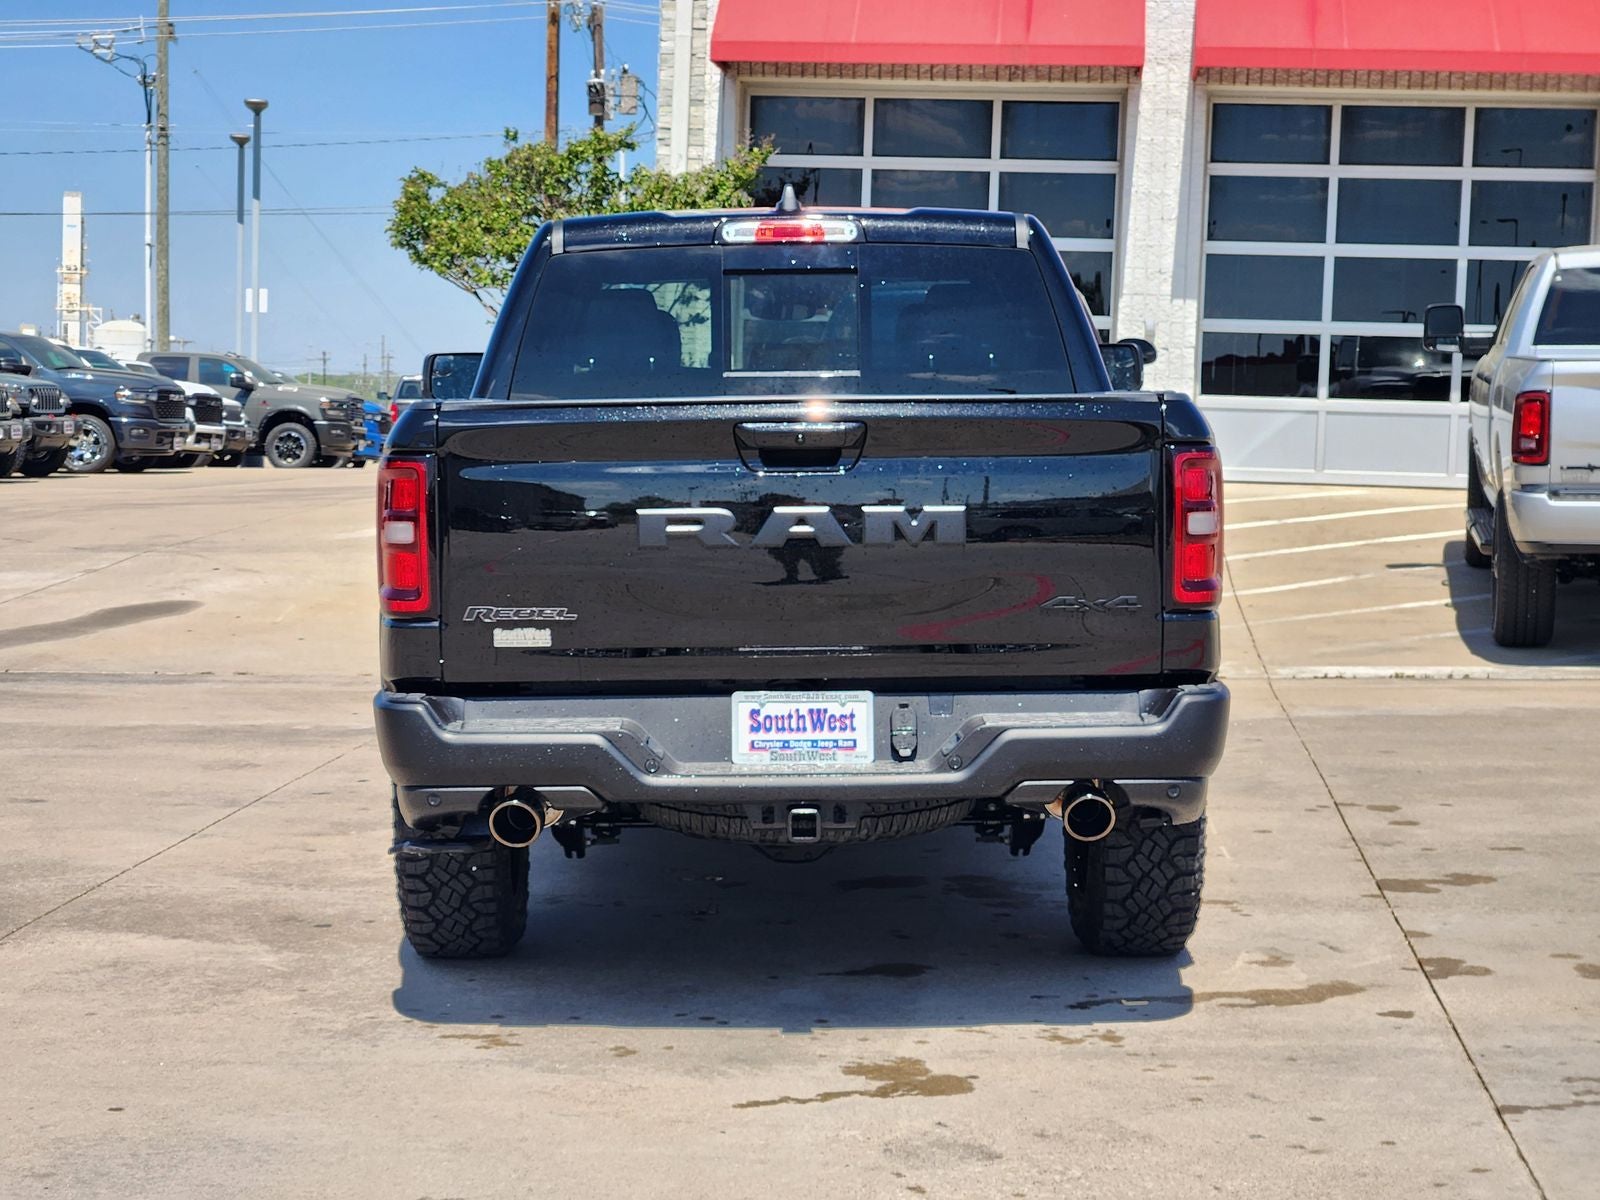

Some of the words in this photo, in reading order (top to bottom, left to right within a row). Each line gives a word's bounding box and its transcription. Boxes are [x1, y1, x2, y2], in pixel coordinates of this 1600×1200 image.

[636, 505, 967, 549] RAM
[462, 605, 578, 622] REBEL
[749, 707, 857, 734] SouthWest
[753, 740, 784, 749] Chrysler
[789, 740, 812, 749] Dodge
[817, 740, 834, 749] Jeep
[837, 740, 855, 748] Ram
[769, 750, 837, 761] SouthWest
